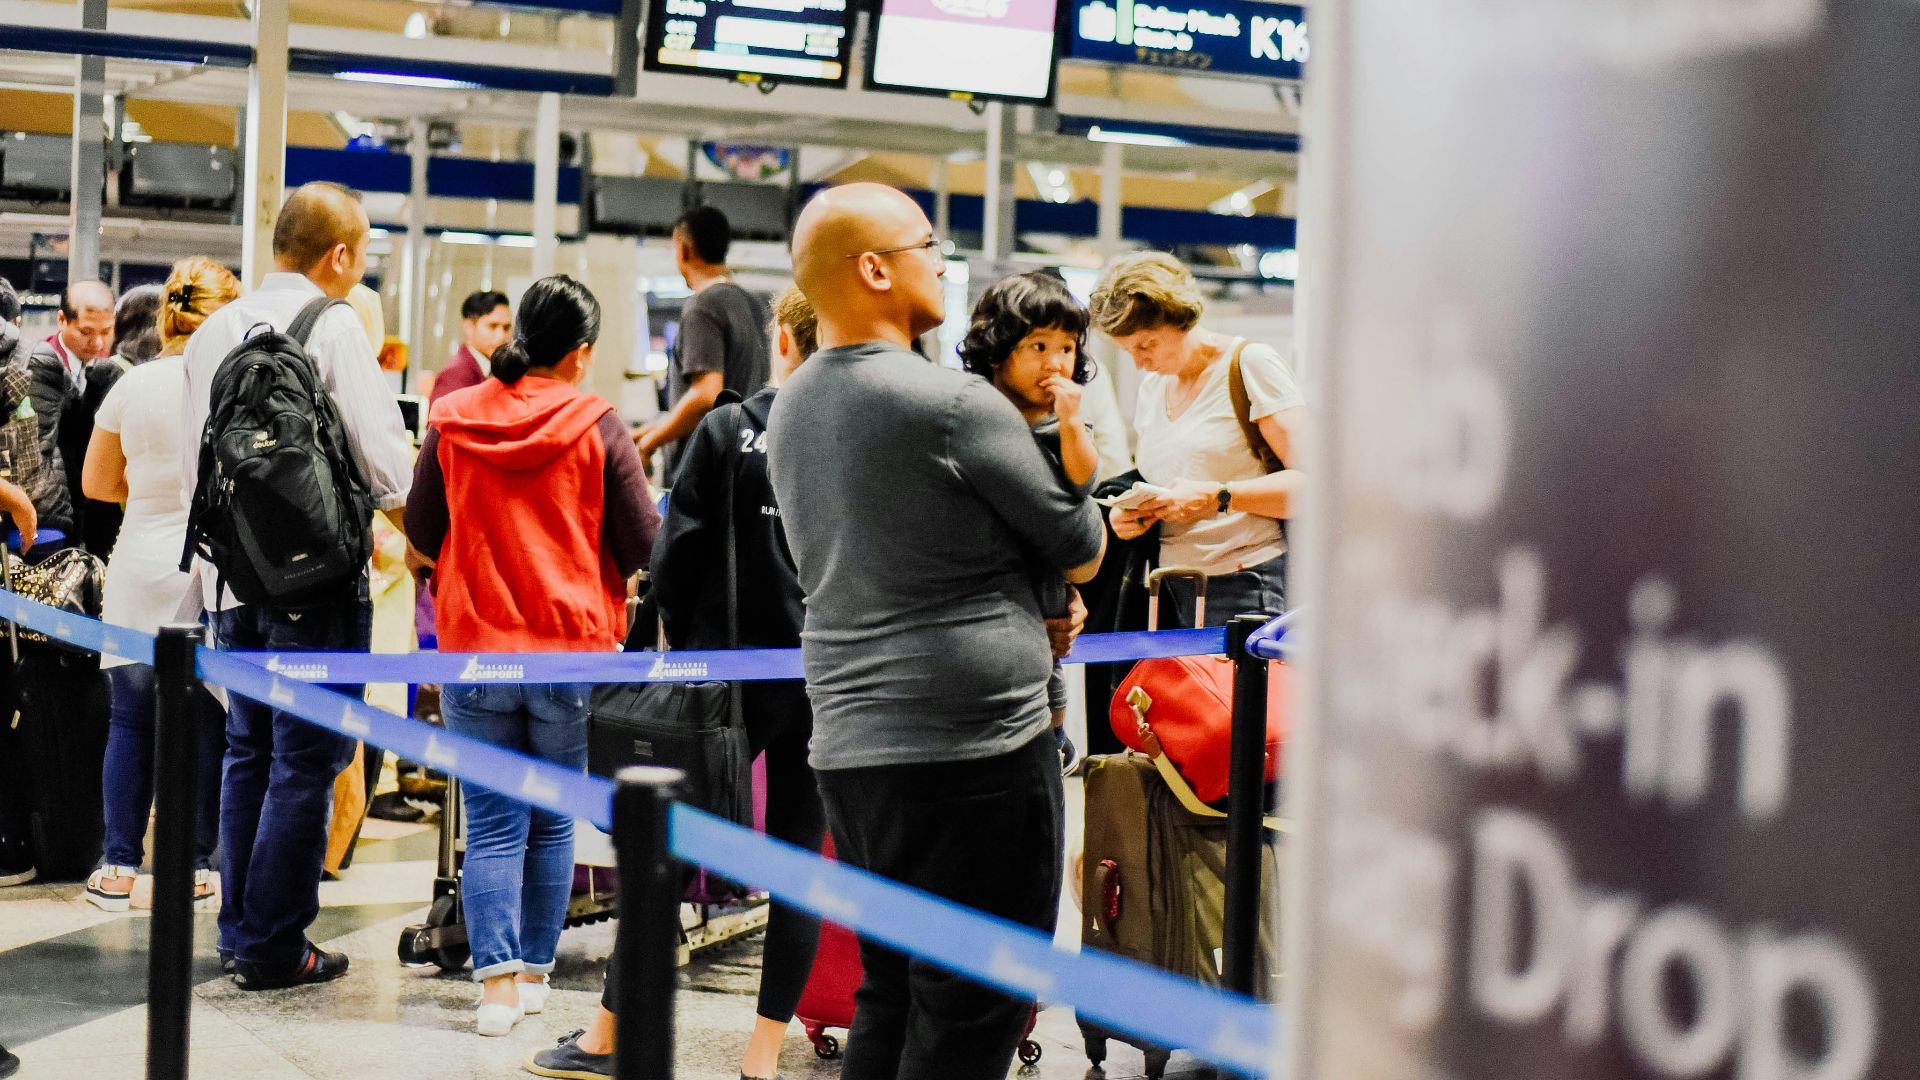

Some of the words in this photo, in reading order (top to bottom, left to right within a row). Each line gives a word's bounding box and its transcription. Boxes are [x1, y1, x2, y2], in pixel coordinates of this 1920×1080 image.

[1250, 16, 1309, 63] K16
[741, 428, 767, 453] 24
[476, 670, 524, 679] AIRPORTS
[663, 668, 708, 677] AIRPORTS
[1360, 540, 1793, 818] ck-in
[1472, 808, 1878, 1080] Drop
